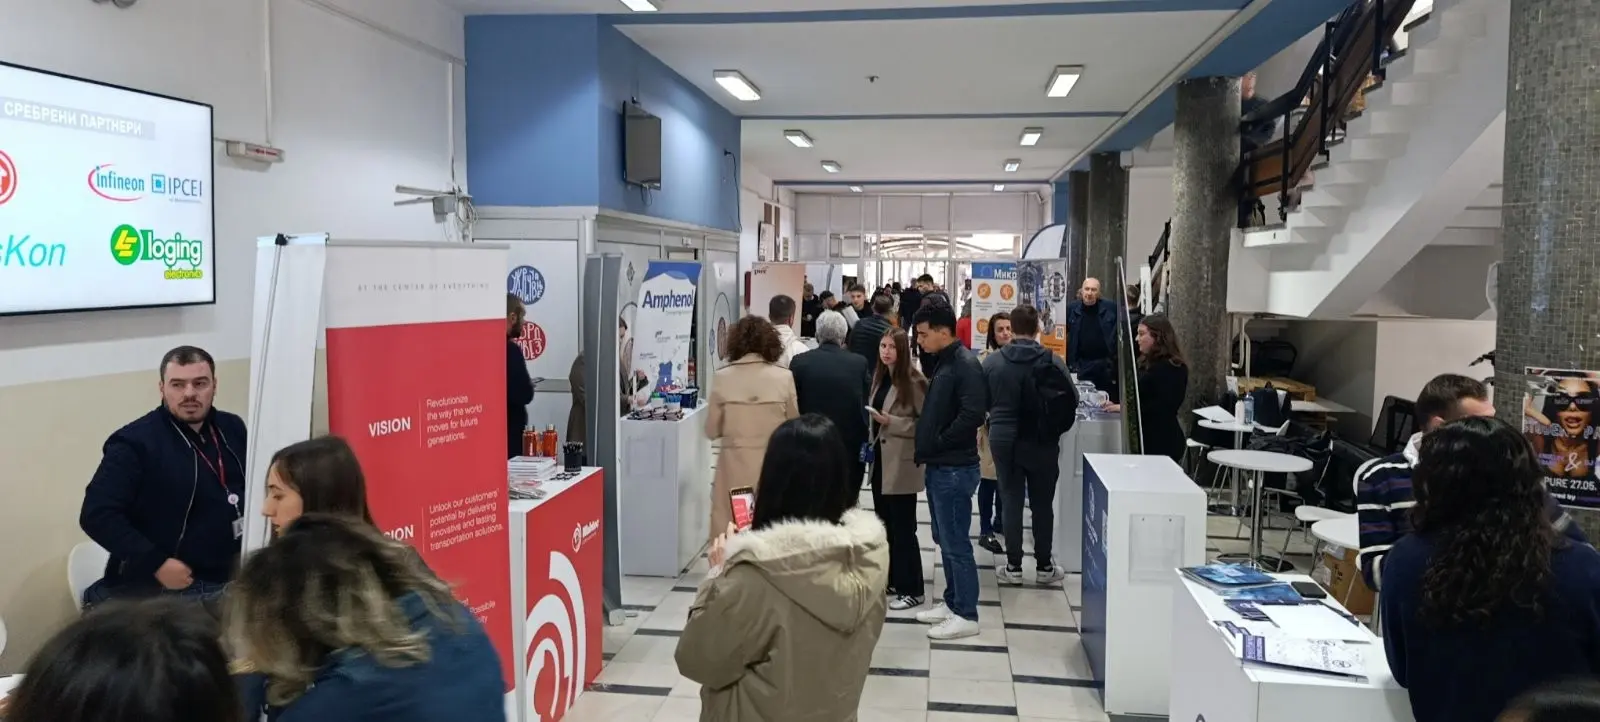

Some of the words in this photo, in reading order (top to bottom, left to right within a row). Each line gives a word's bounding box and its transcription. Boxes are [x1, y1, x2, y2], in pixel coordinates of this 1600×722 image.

[4, 101, 77, 126] СРЕБРЕНИ
[80, 113, 143, 136] ПАРТНЕРИ
[96, 166, 145, 191] infineon
[168, 177, 202, 197] IPCEI
[0, 234, 66, 267] Kon
[146, 231, 202, 267] loging
[642, 289, 694, 312] Amphenol
[426, 395, 468, 409] Revolutionize
[426, 412, 438, 421] the
[438, 410, 453, 420] way
[453, 408, 464, 417] the
[464, 404, 483, 414] world
[368, 416, 411, 438] VISION
[427, 422, 449, 433] moves
[450, 419, 460, 429] for
[460, 417, 479, 428] future
[427, 431, 467, 448] generations.
[1544, 476, 1569, 489] PURE
[429, 501, 453, 514] Unlock
[452, 498, 464, 508] our
[429, 511, 457, 529] potential
[457, 510, 466, 520] by
[467, 502, 497, 516] delivering
[430, 522, 462, 539] innovative
[462, 518, 475, 529] and
[475, 513, 497, 525] lasting
[430, 530, 474, 551] transportation
[474, 523, 504, 538] solutions.
